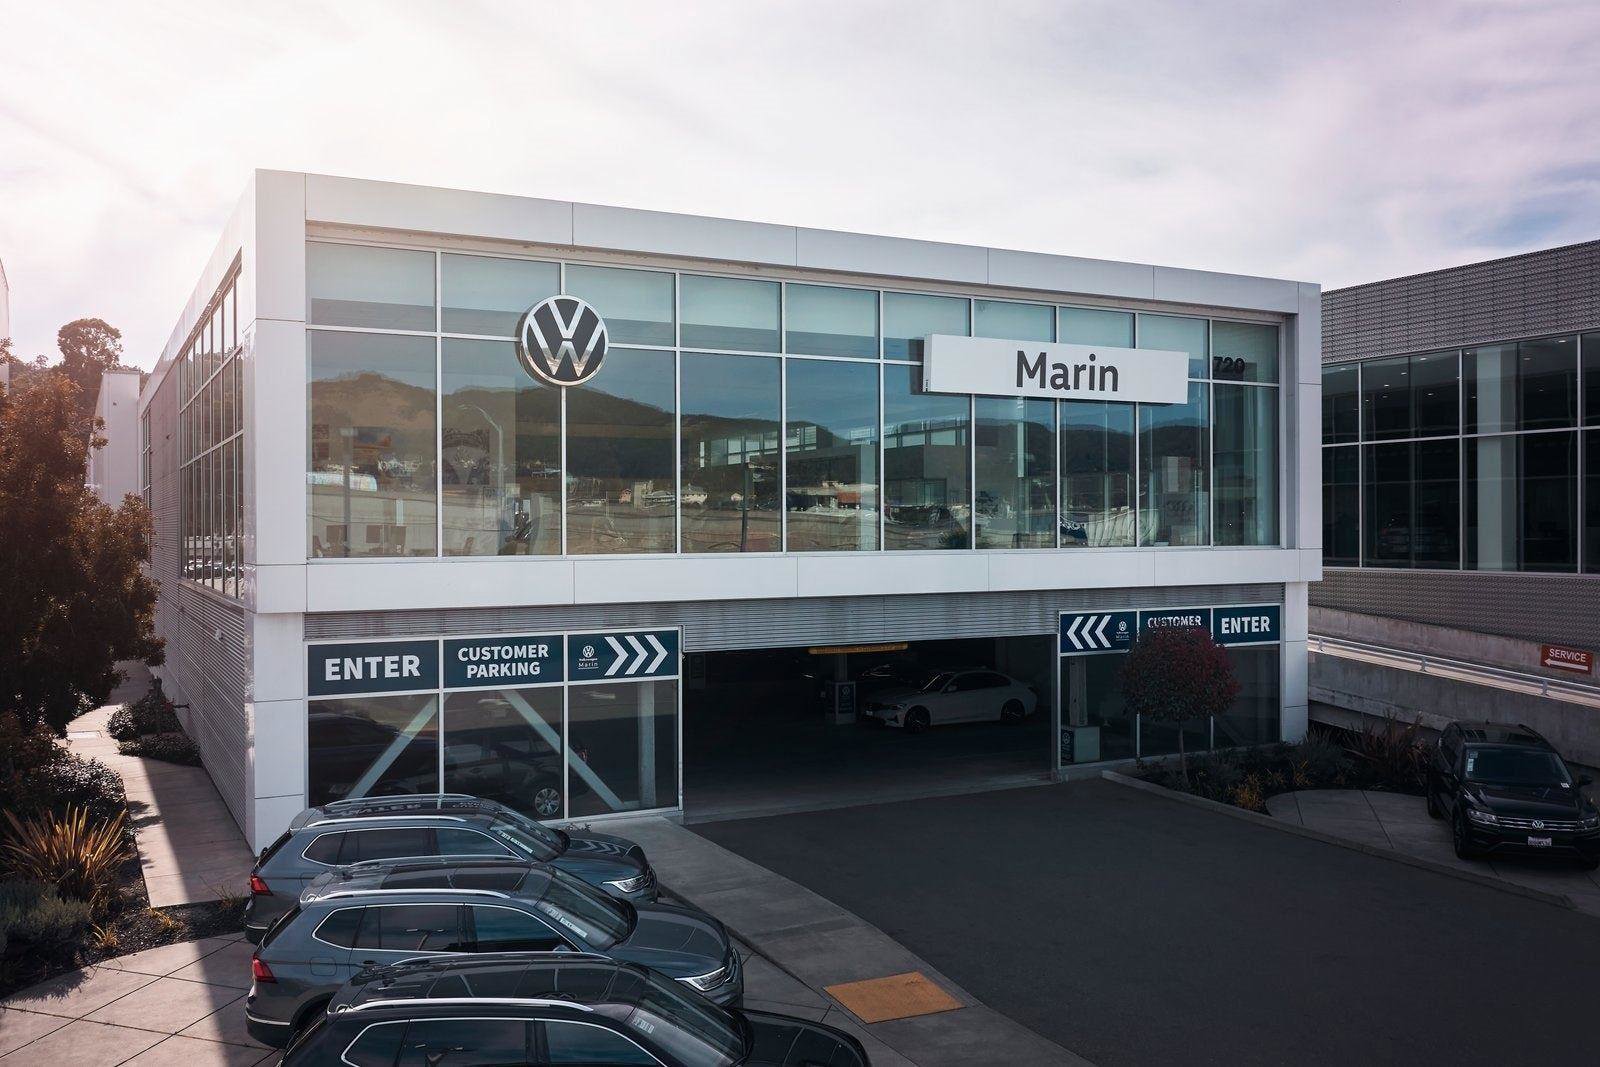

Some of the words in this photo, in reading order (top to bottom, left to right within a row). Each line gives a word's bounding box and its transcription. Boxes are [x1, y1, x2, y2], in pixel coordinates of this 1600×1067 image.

[1016, 350, 1119, 392] Marin
[1213, 356, 1245, 374] 720
[1221, 616, 1271, 634] ENTER
[457, 643, 550, 662] CUSTOMER
[1549, 648, 1587, 662] SERVICE
[325, 655, 421, 682] ENTER
[466, 661, 541, 678] PARKING
